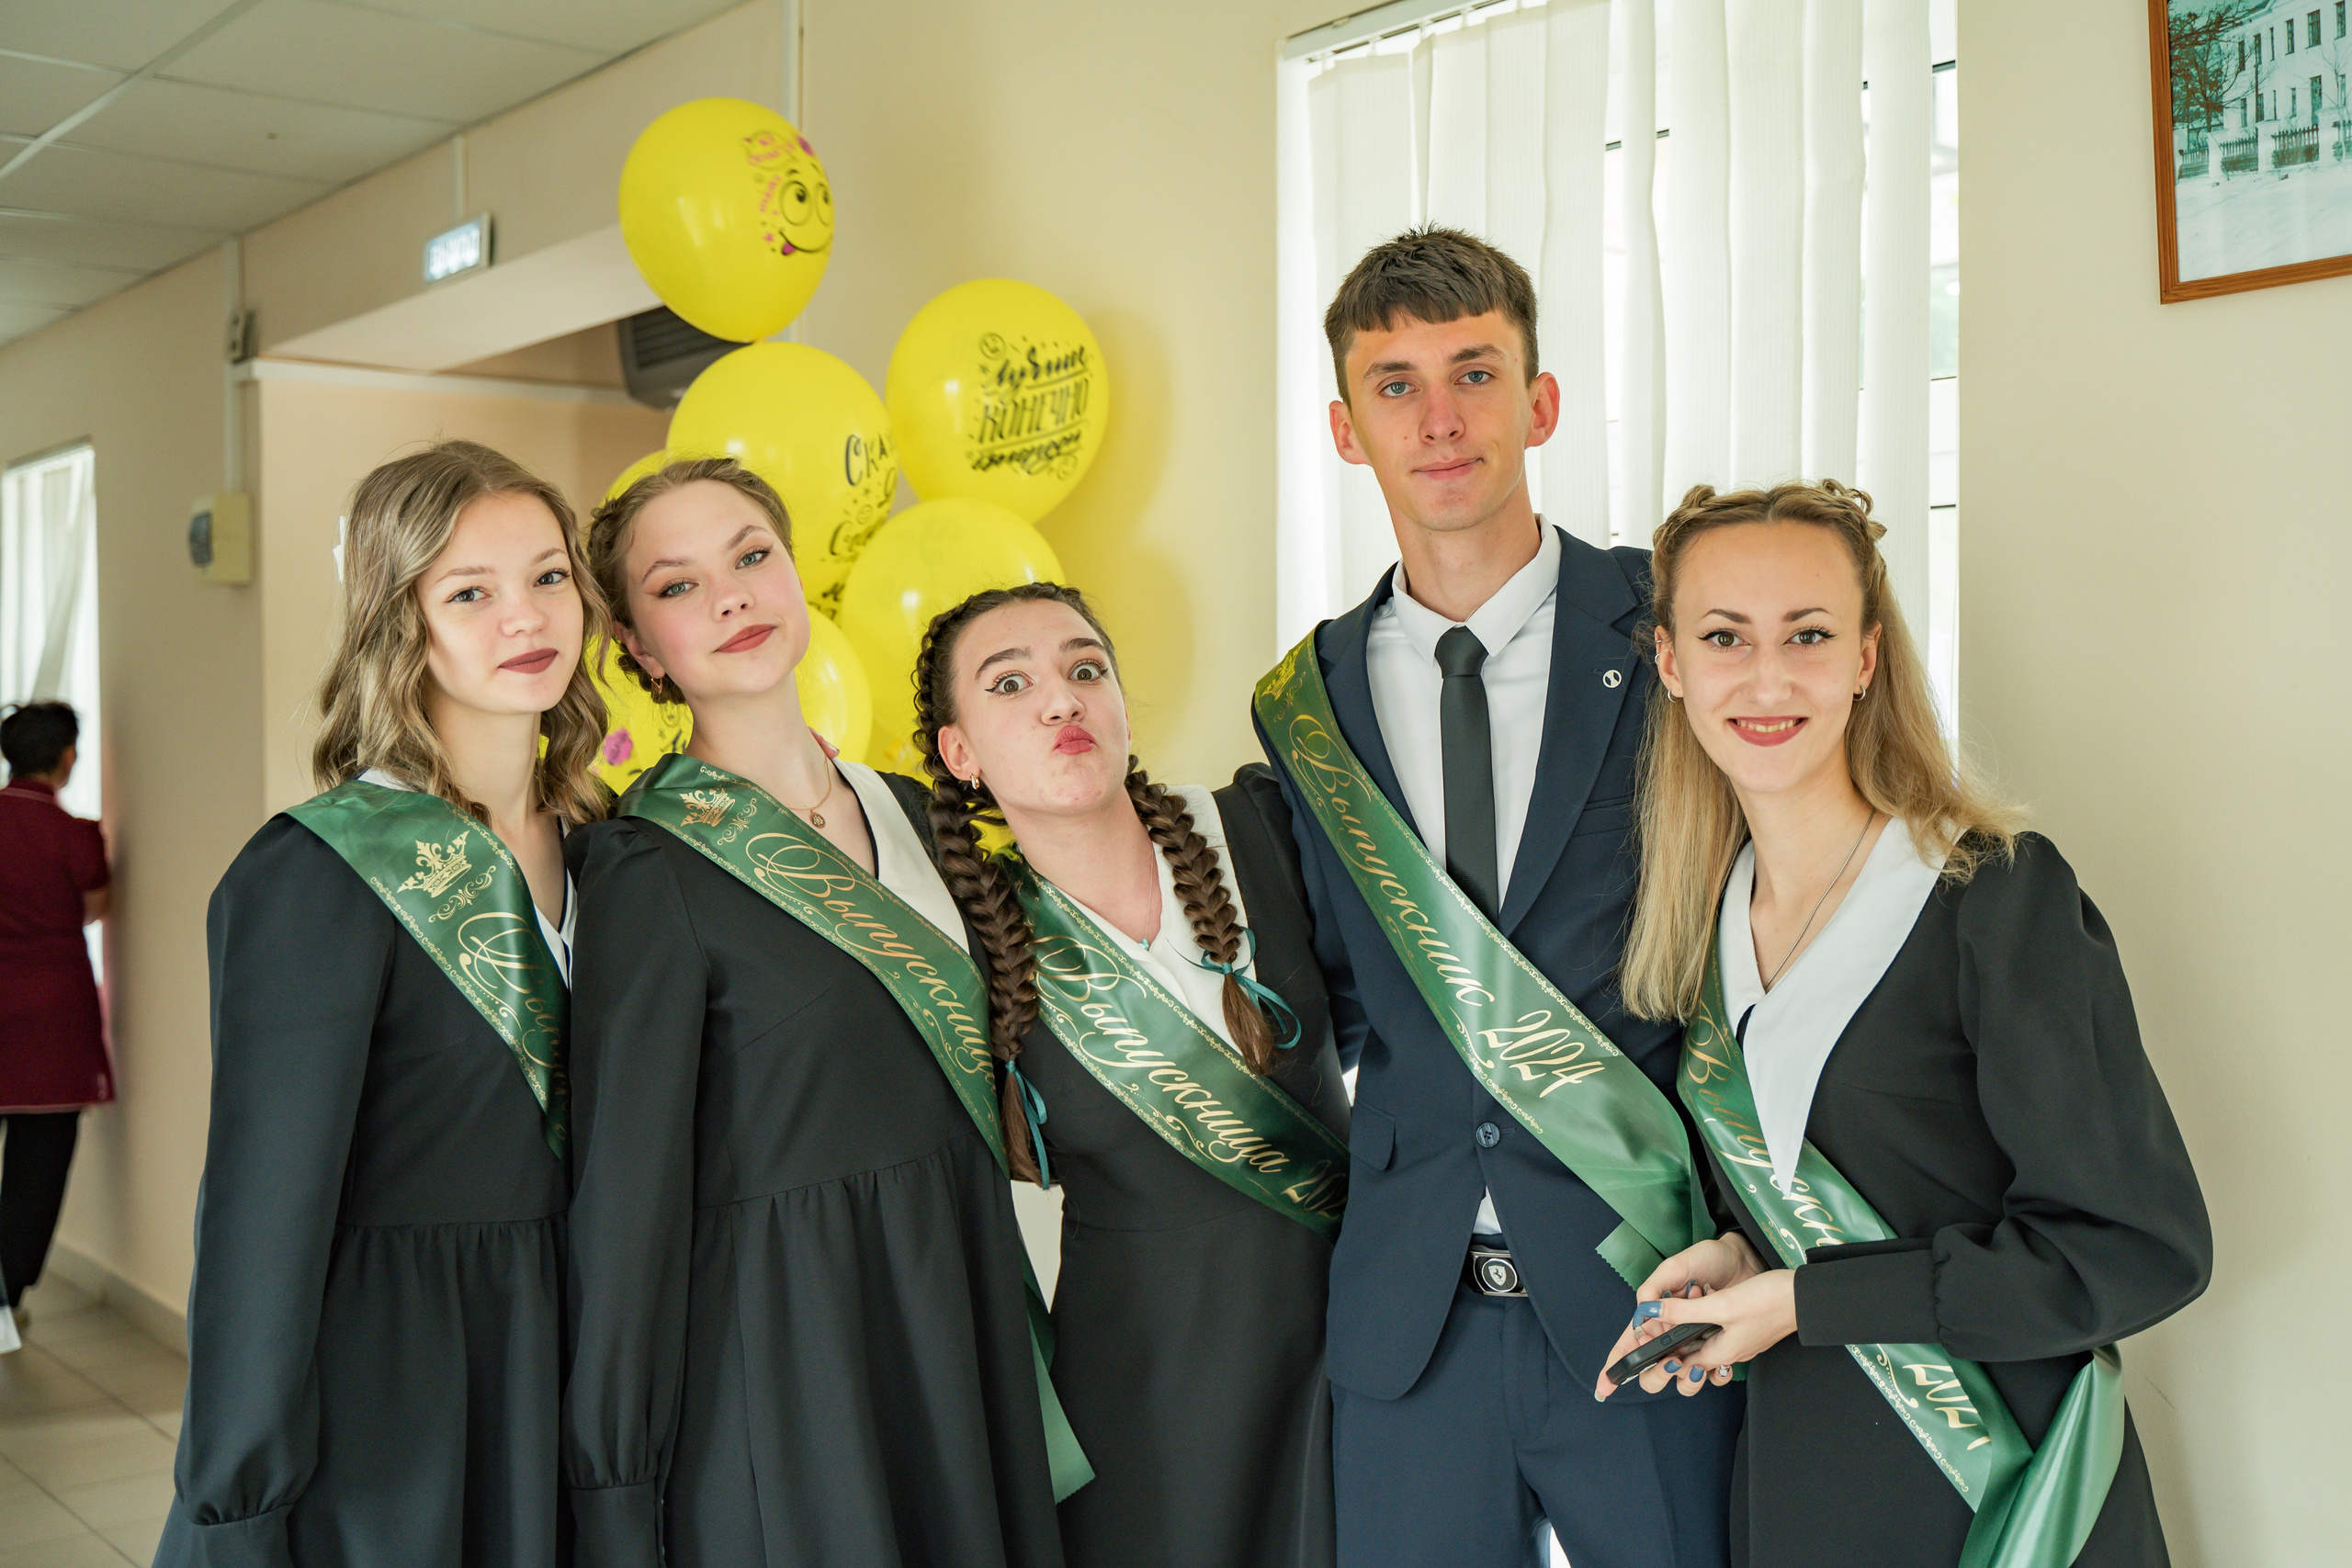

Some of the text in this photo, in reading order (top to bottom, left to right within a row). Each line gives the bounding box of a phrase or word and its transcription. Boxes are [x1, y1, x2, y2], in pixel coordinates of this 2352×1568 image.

[1023, 934, 1291, 1174] Выпускница
[1289, 714, 1606, 1099] Выпускник 2024
